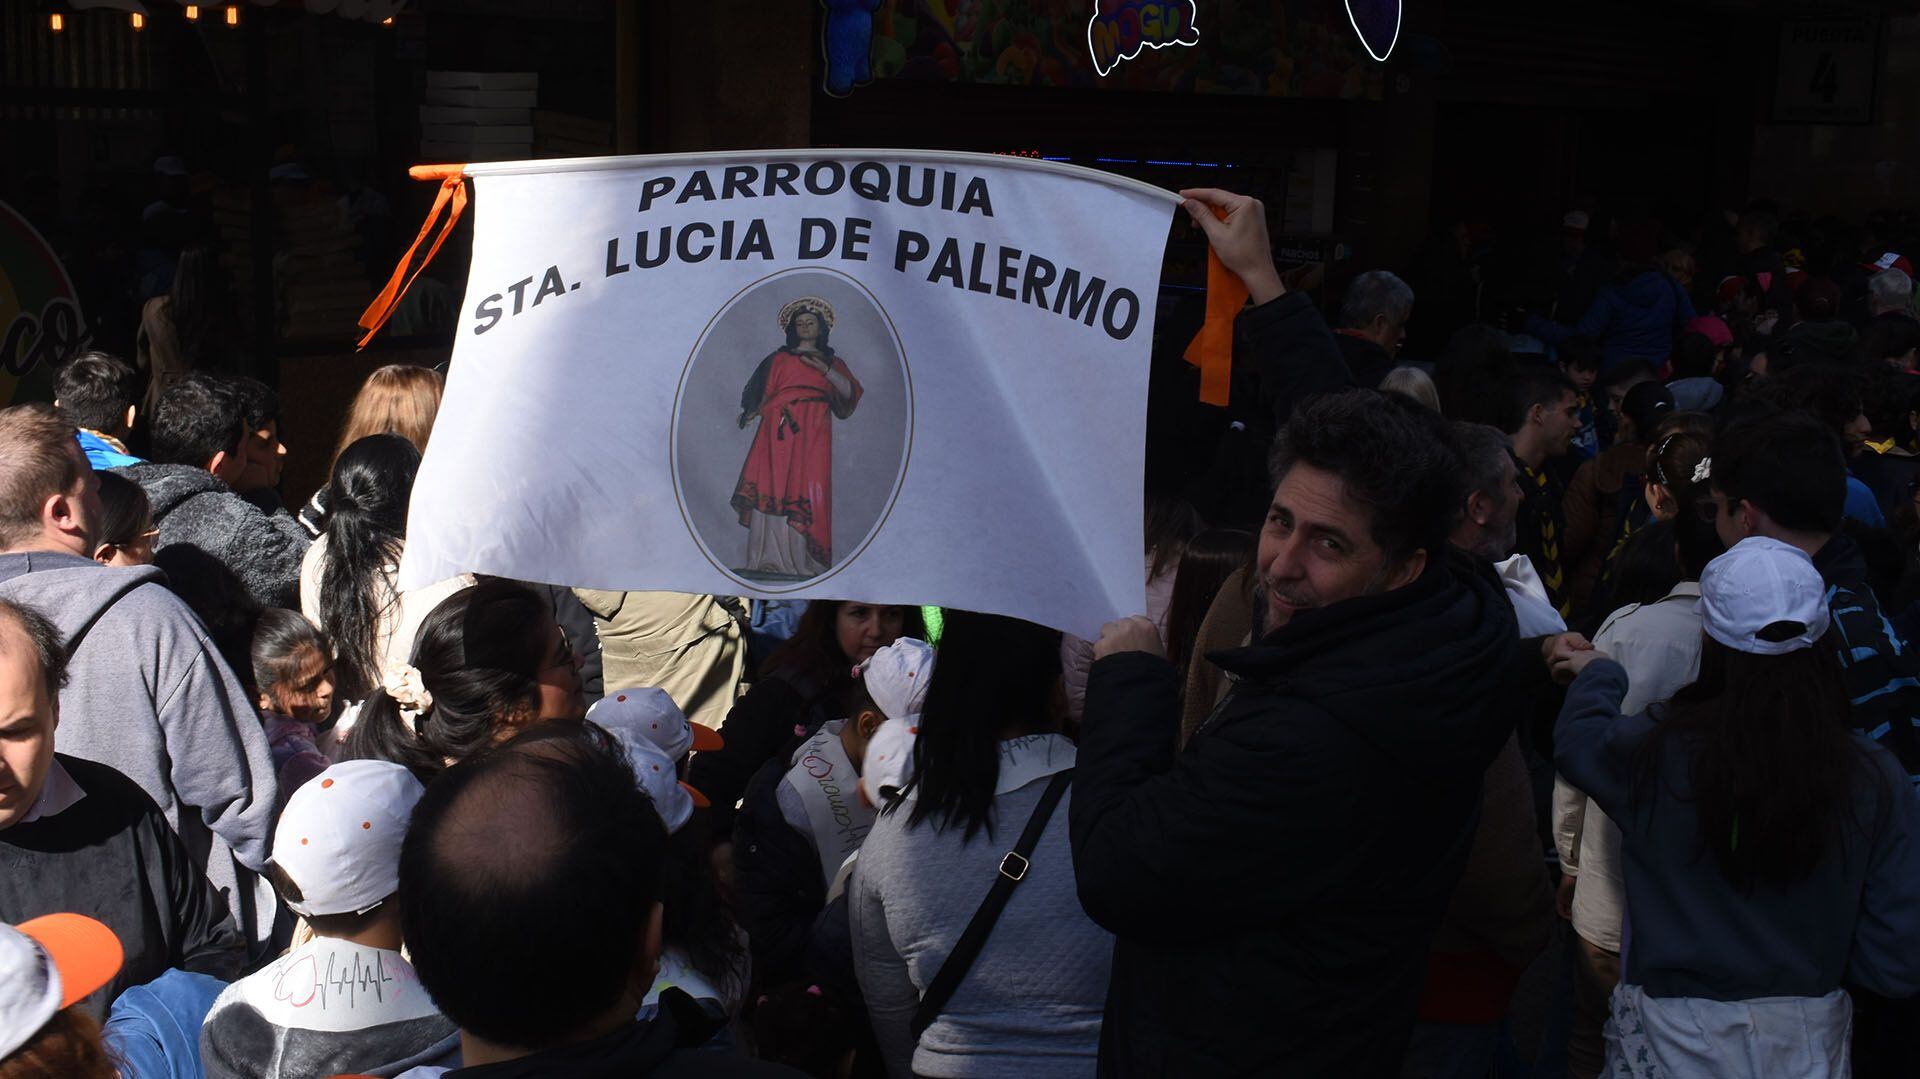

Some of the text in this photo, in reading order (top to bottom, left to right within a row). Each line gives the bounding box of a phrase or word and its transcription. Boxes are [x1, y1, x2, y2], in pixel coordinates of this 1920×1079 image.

[1094, 4, 1194, 66] MOGUL
[1810, 53, 1838, 102] 4
[638, 160, 994, 217] PARROQUIA
[474, 218, 1139, 341] STA. LUCIA DE PALERMO
